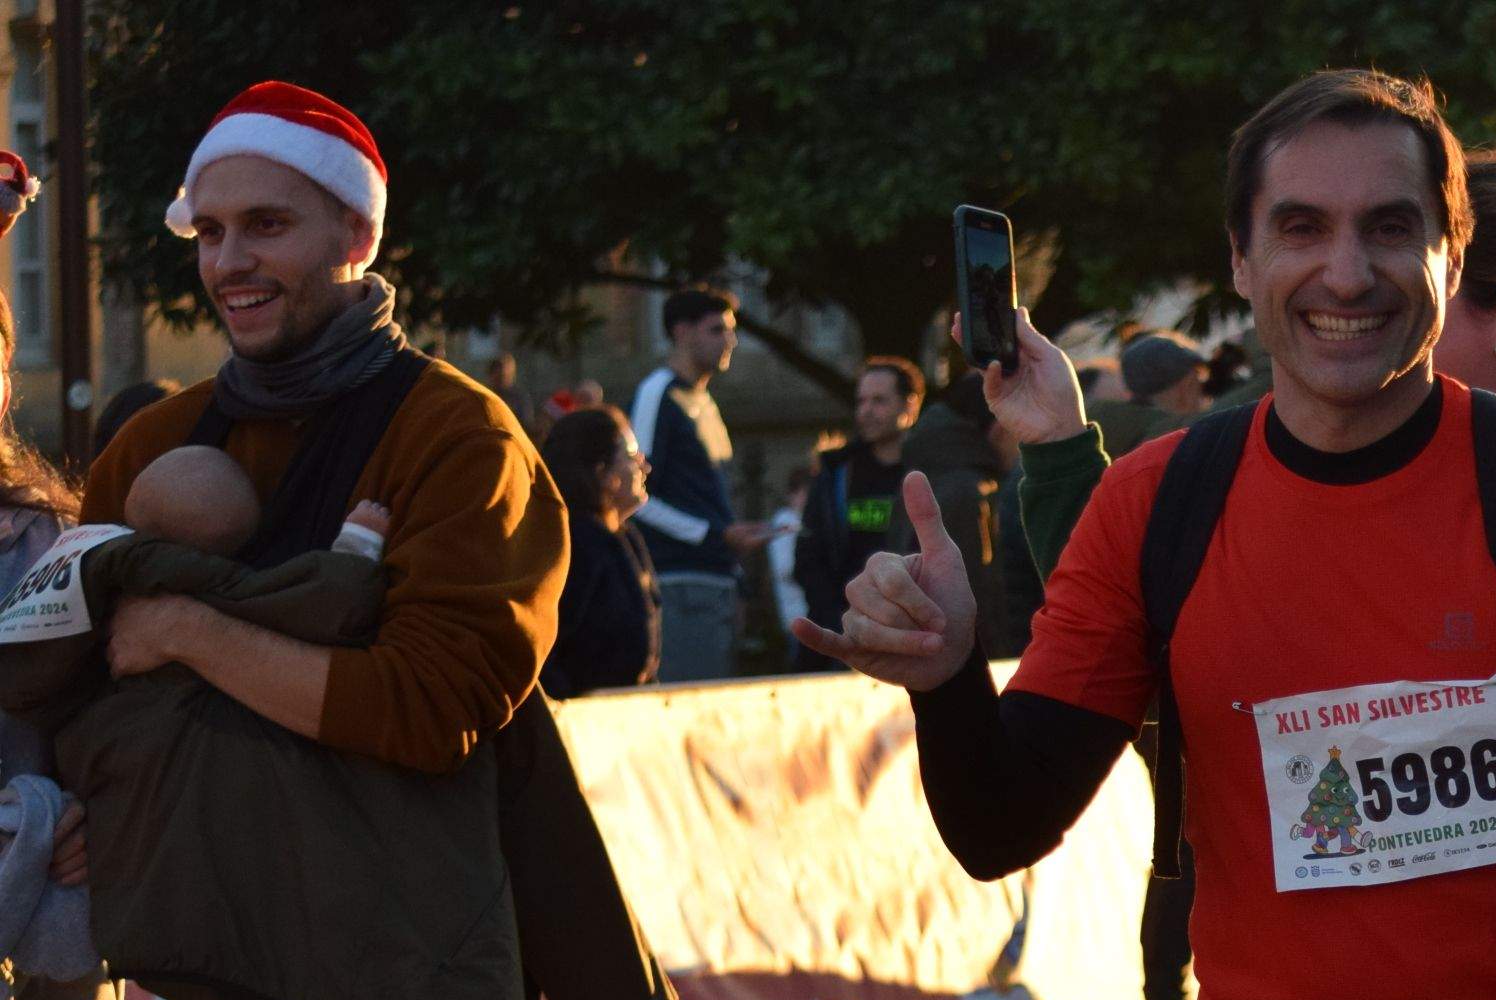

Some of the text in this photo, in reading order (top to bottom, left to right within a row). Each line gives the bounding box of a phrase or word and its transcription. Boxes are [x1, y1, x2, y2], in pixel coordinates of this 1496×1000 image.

[40, 602, 69, 616] 2024
[1275, 686, 1486, 735] XLI SAN SILVESTRE
[1368, 825, 1464, 852] PONTEVEDRA
